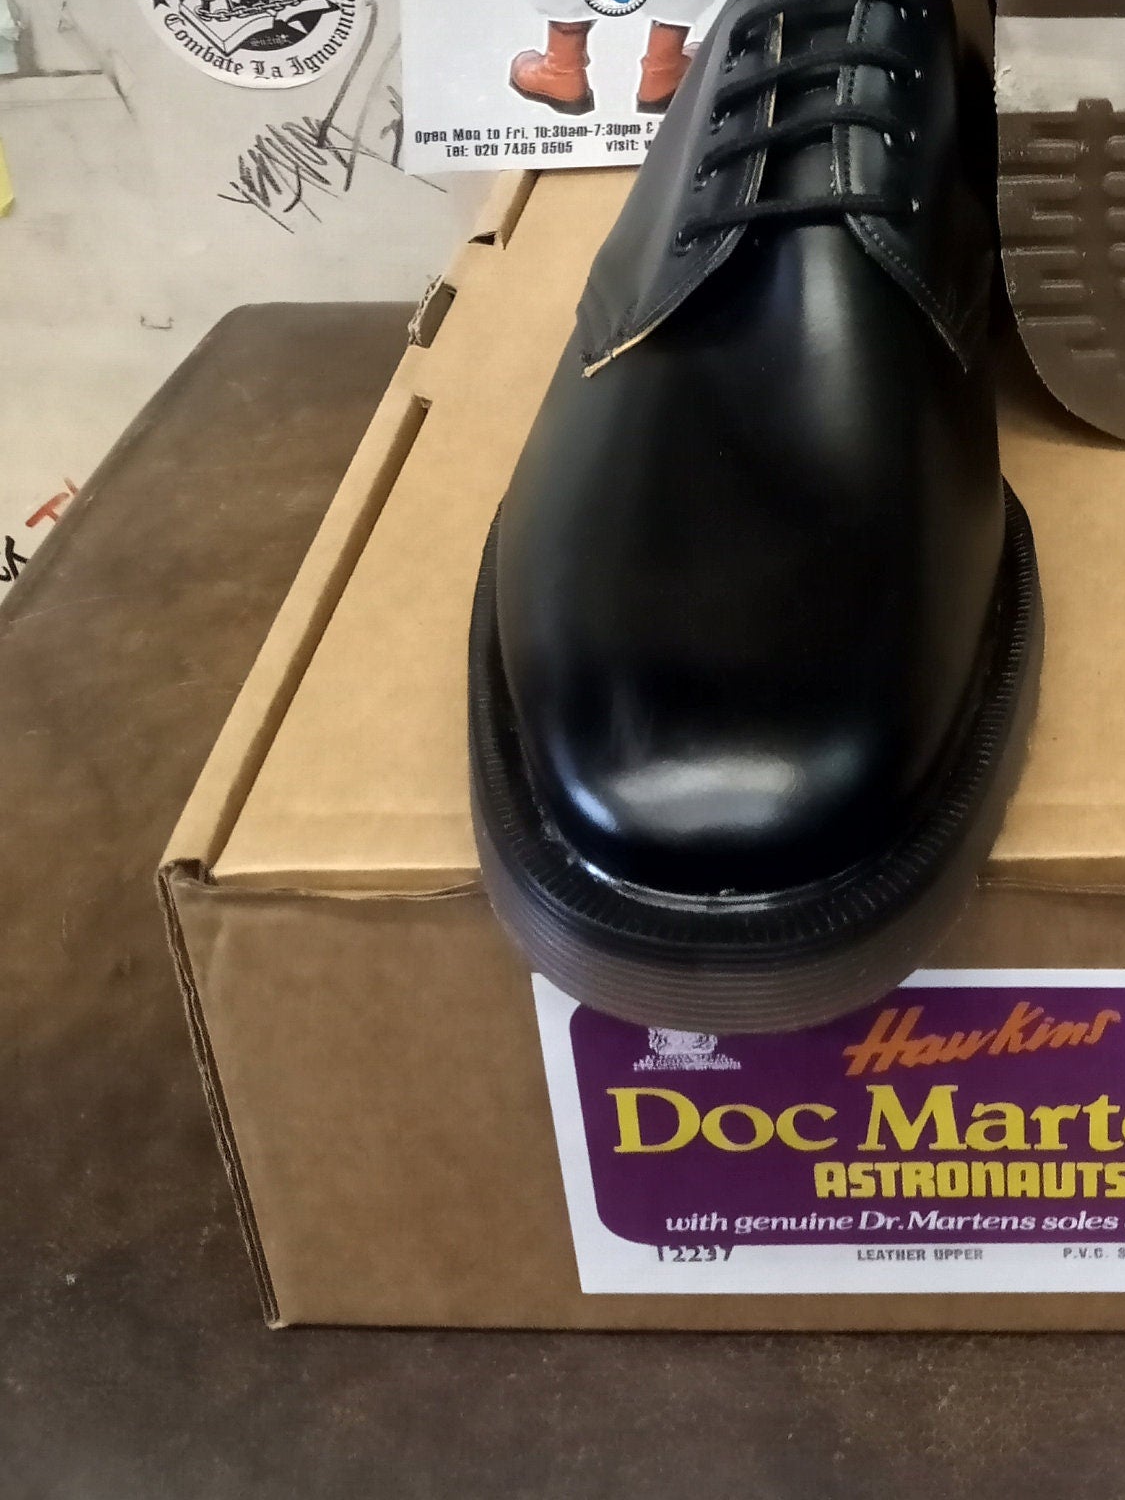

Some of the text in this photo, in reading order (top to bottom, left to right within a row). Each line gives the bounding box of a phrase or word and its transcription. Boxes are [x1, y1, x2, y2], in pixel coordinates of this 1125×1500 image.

[606, 1086, 840, 1153] Doc
[665, 1211, 729, 1233] with
[733, 1212, 853, 1236] genuine
[1041, 1210, 1119, 1231] soles
[857, 1248, 926, 1262] LEATHER
[934, 1248, 983, 1261] UPPER
